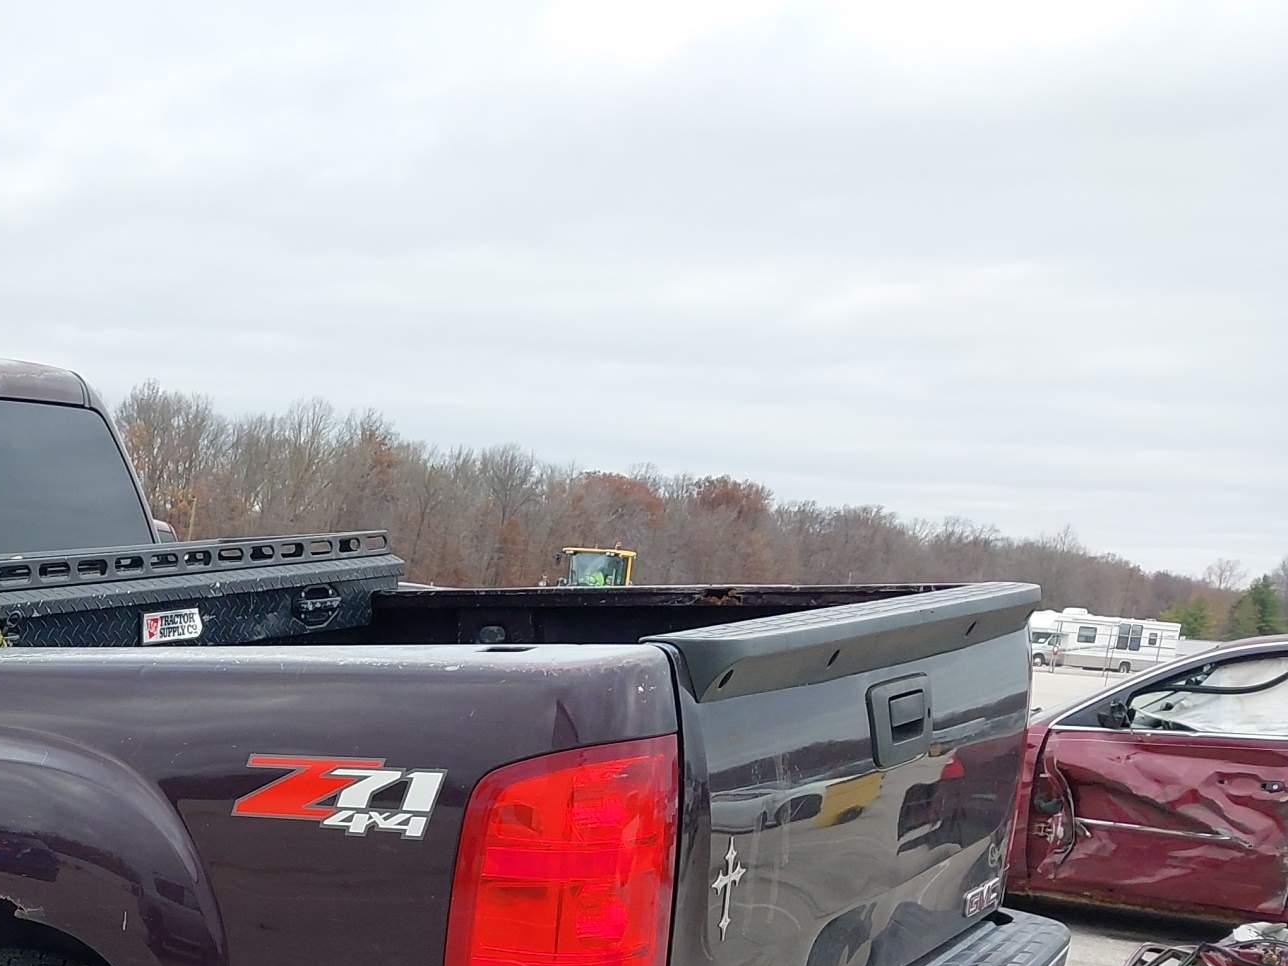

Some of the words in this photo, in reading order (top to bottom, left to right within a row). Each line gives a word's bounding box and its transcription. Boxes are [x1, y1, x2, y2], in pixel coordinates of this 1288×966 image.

[159, 612, 196, 627] TRACTOR
[159, 625, 186, 638] SUPPLY
[231, 753, 448, 820] Z71
